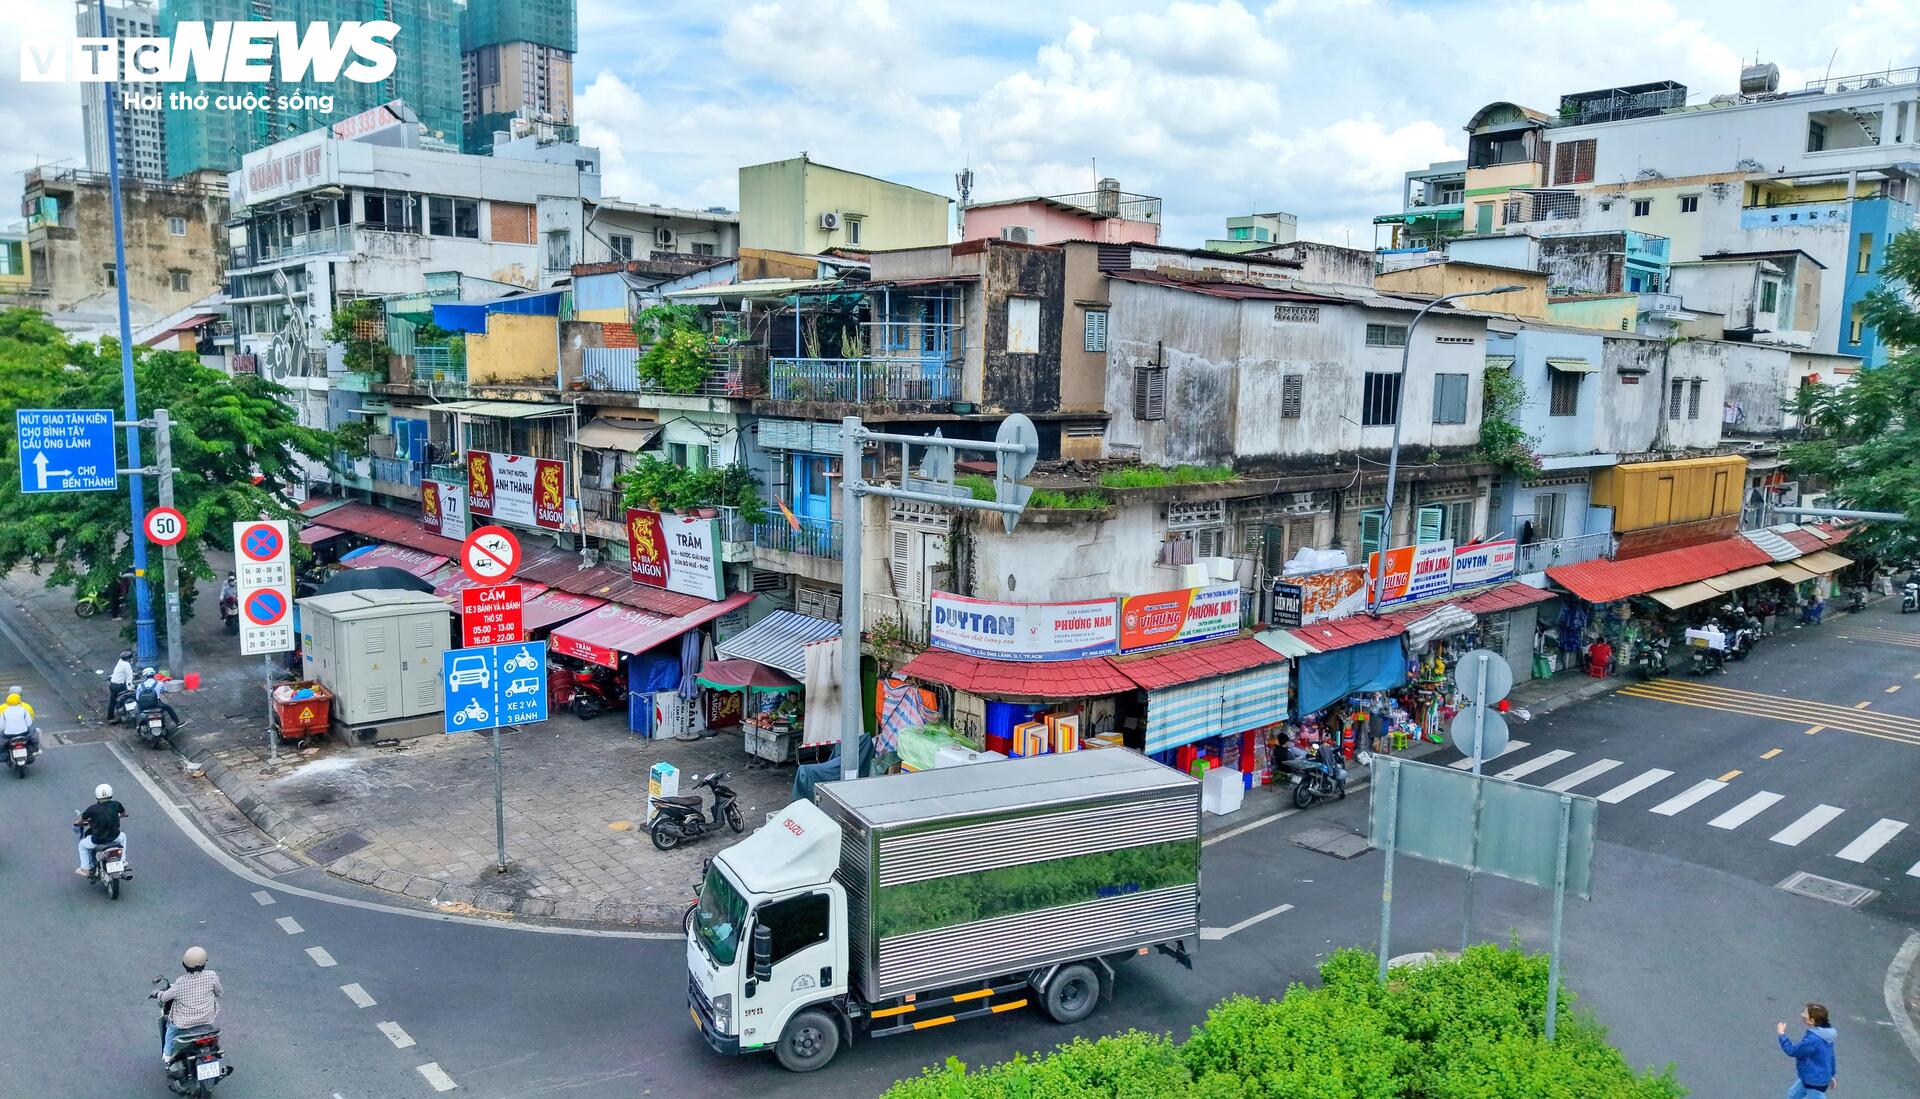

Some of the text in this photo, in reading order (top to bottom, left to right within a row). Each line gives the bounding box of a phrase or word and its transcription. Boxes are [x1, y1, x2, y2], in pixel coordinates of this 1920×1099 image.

[20, 412, 107, 425] NÚT GIAO TÂN KIÊN
[22, 425, 85, 438] CHỢ BÌNH TÂY
[22, 437, 41, 449] CẦU
[44, 438, 63, 449] ÔNG
[77, 465, 96, 476] CHỢ
[62, 475, 114, 488] BẾN THÀNH
[495, 479, 532, 495] ANH THÀNH
[447, 496, 457, 513] 77
[469, 495, 490, 509] SAIGON
[546, 502, 554, 510] BIA
[423, 516, 439, 526] SAIGON
[538, 508, 563, 523] SAIGON
[156, 518, 175, 534] 50
[676, 532, 702, 550] TRÂM
[640, 555, 651, 563] BIA
[1435, 556, 1451, 571] LANG
[1456, 554, 1488, 571] DUYTAN
[632, 561, 662, 577] SAIGON
[479, 588, 506, 602] CẤM
[465, 605, 473, 614] XE
[472, 605, 477, 613] 3
[476, 603, 492, 613] BÁNH
[493, 601, 501, 611] VÀ
[506, 601, 521, 611] BÁNH
[1187, 602, 1218, 620] PHƯƠNG
[484, 613, 495, 622] THÔ
[935, 605, 1015, 636] DUYTAN
[1054, 615, 1112, 631] PHƯƠNG NAM
[473, 625, 492, 634] 05:00
[498, 622, 515, 632] 13:00
[473, 636, 491, 645] 16:00
[496, 632, 515, 642] 22:00
[575, 642, 592, 652] TRÂM
[507, 698, 538, 711] XE 2 VÀ
[507, 712, 538, 723] 3 BÁNH
[783, 818, 805, 837] ISUZU
